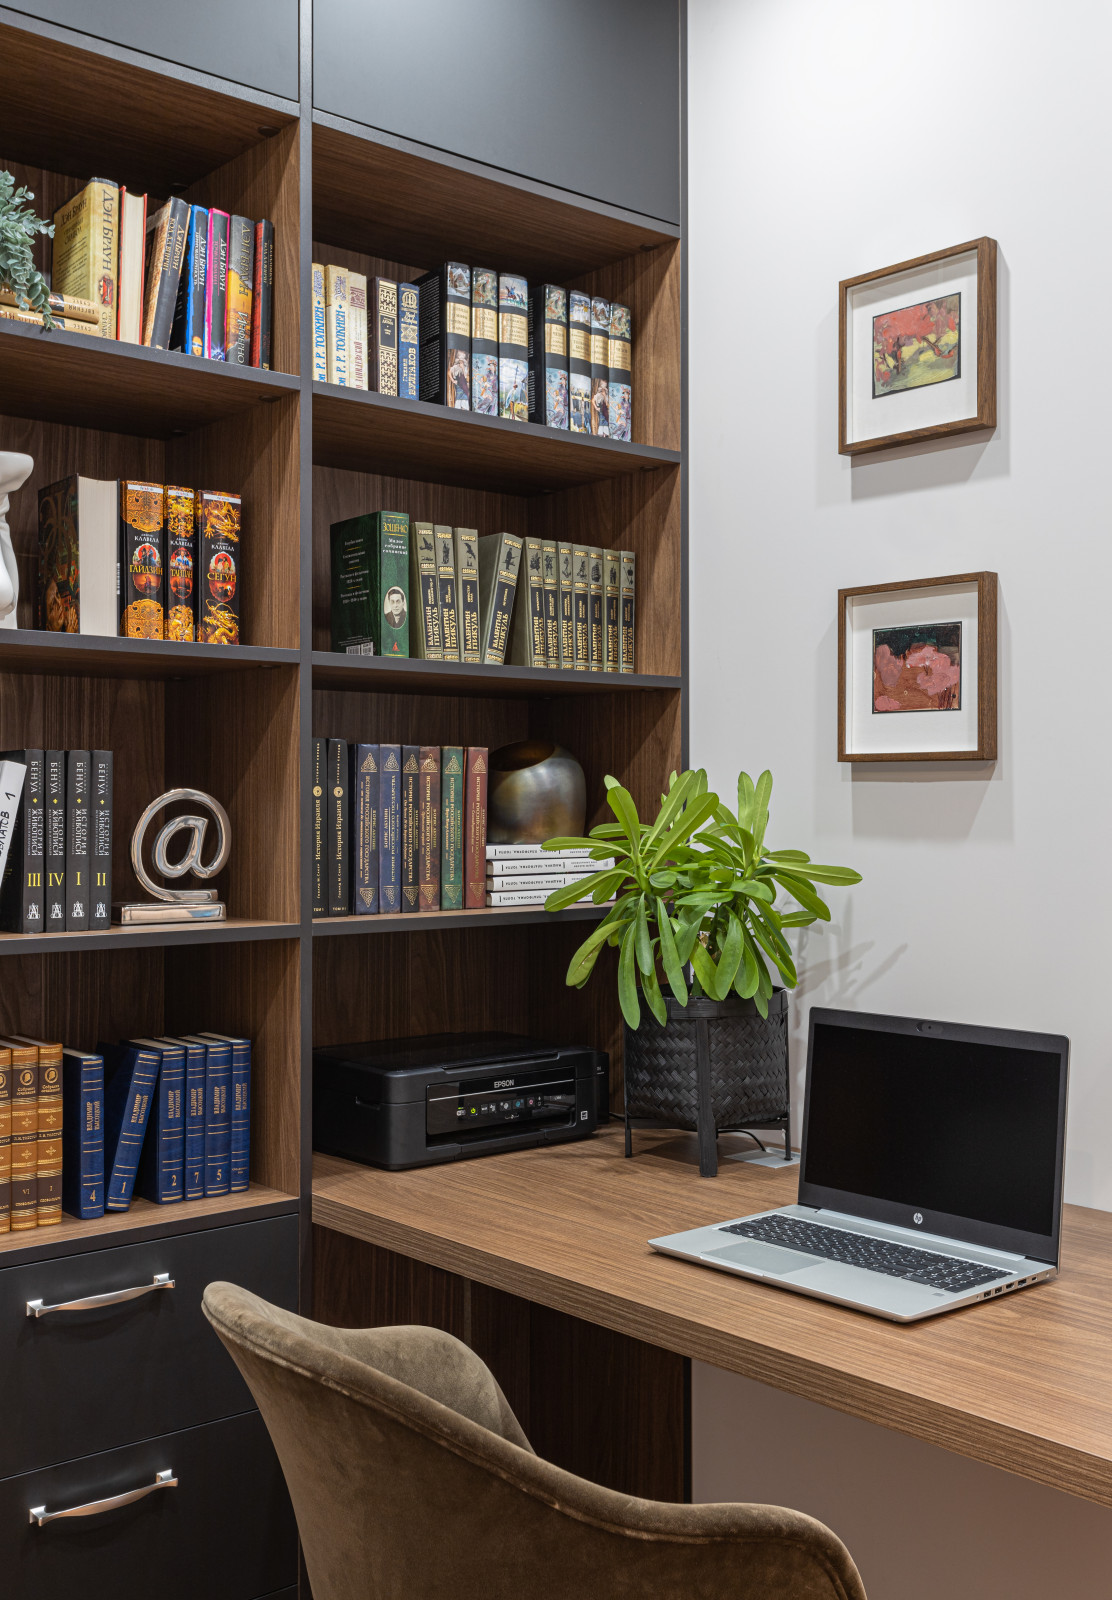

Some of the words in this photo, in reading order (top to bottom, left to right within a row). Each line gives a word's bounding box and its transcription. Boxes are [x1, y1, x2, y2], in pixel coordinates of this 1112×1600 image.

[102, 190, 113, 223] ДЭН
[102, 226, 113, 271] БРАУН
[432, 607, 440, 646] ПИКУЛЬ
[443, 609, 451, 647] ВАЛЕНТИН
[449, 609, 457, 647] ПИКУЛЬ
[492, 611, 502, 648] ВАЛЕНТИН
[498, 613, 509, 650] ПИКУЛЬ
[30, 762, 38, 792] БЕНУА
[50, 762, 58, 793] БЕНУА
[5, 792, 15, 800] 1
[131, 788, 232, 901] @
[335, 831, 343, 860] История
[28, 873, 41, 887] III
[49, 872, 64, 887] IV
[76, 872, 81, 886] I
[97, 873, 106, 886] II
[494, 1079, 515, 1089] EPSON
[86, 1102, 94, 1131] ВЛАДИМИР
[130, 1094, 141, 1123] ВЛАДИМИР
[121, 1181, 127, 1193] 1
[171, 1175, 177, 1187] 2
[193, 1172, 199, 1184] 7
[216, 1169, 222, 1180] 5
[90, 1190, 96, 1202] 4
